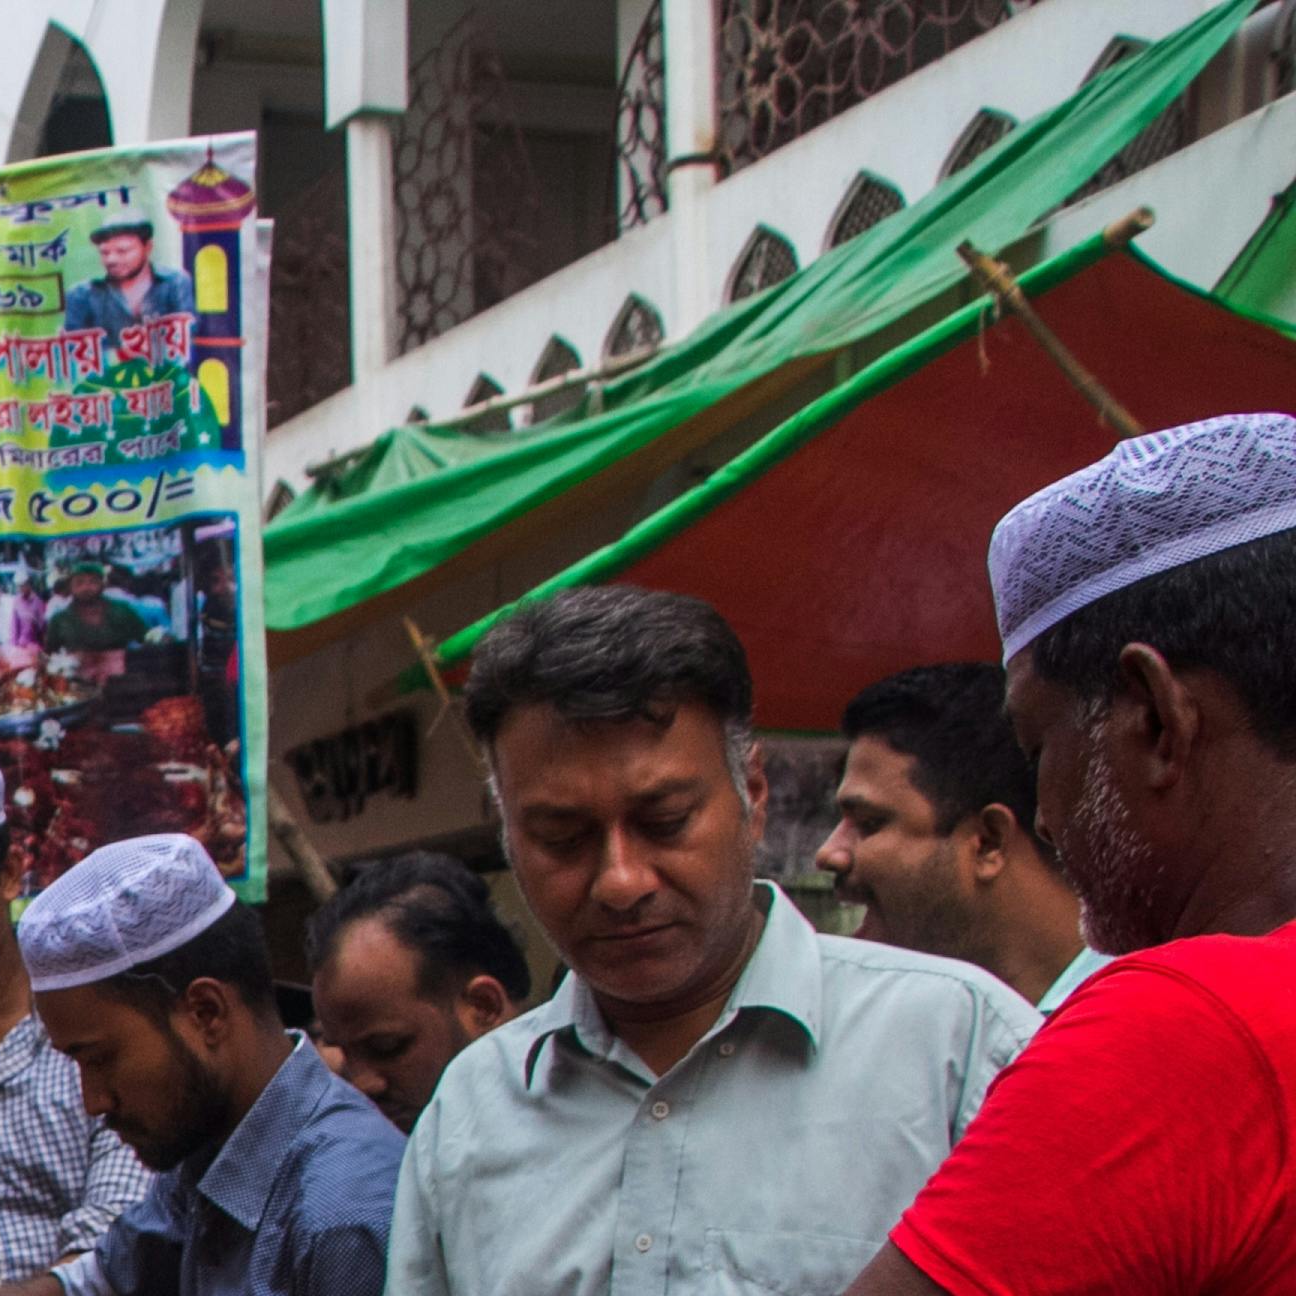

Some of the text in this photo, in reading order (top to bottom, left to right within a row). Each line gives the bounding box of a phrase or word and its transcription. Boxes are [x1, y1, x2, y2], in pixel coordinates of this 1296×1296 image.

[0, 228, 70, 268] মার্ক
[118, 315, 195, 369] খায়
[26, 390, 115, 432] লইয়া
[126, 380, 175, 420] যায়
[28, 471, 197, 524] ৫০০/=
